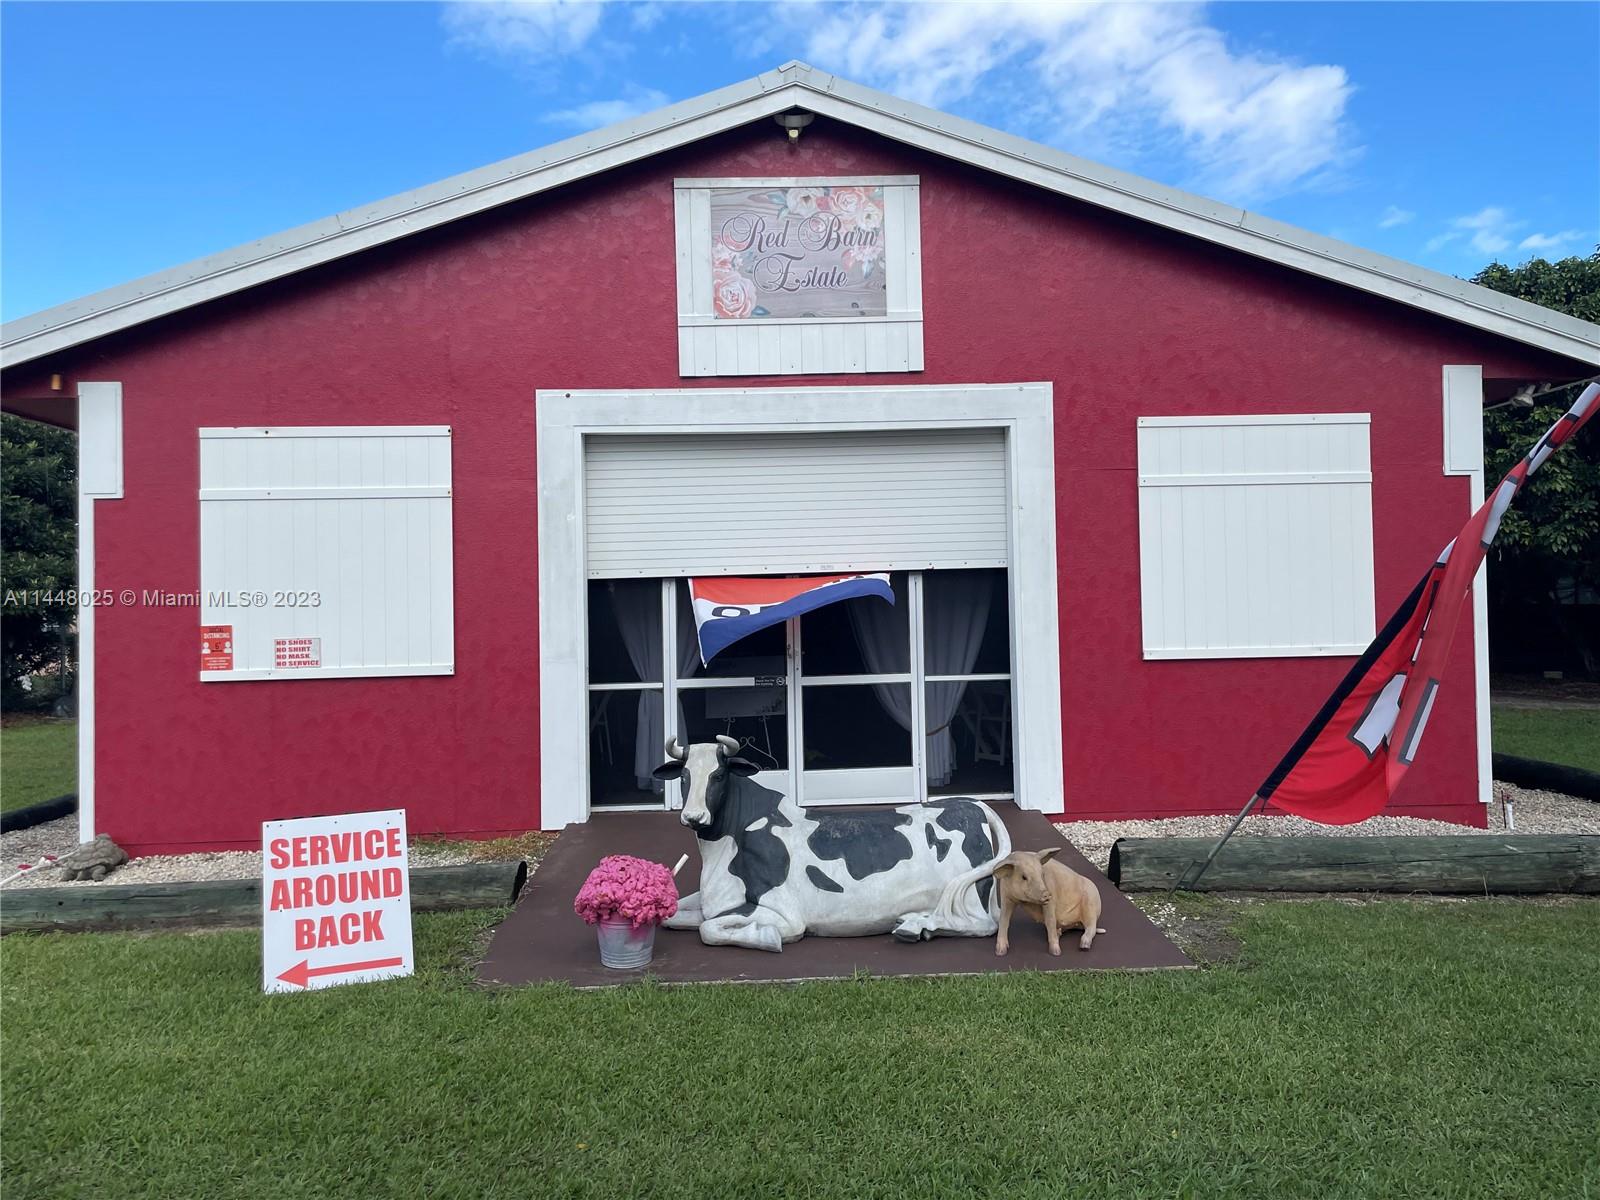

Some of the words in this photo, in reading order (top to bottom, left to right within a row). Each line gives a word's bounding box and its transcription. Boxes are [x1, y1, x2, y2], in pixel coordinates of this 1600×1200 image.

[721, 212, 789, 253] Red
[798, 211, 877, 251] Barn
[754, 252, 848, 292] Estate
[270, 828, 402, 869] SERVICE
[270, 867, 403, 911] AROUND
[295, 910, 385, 951] BACK
